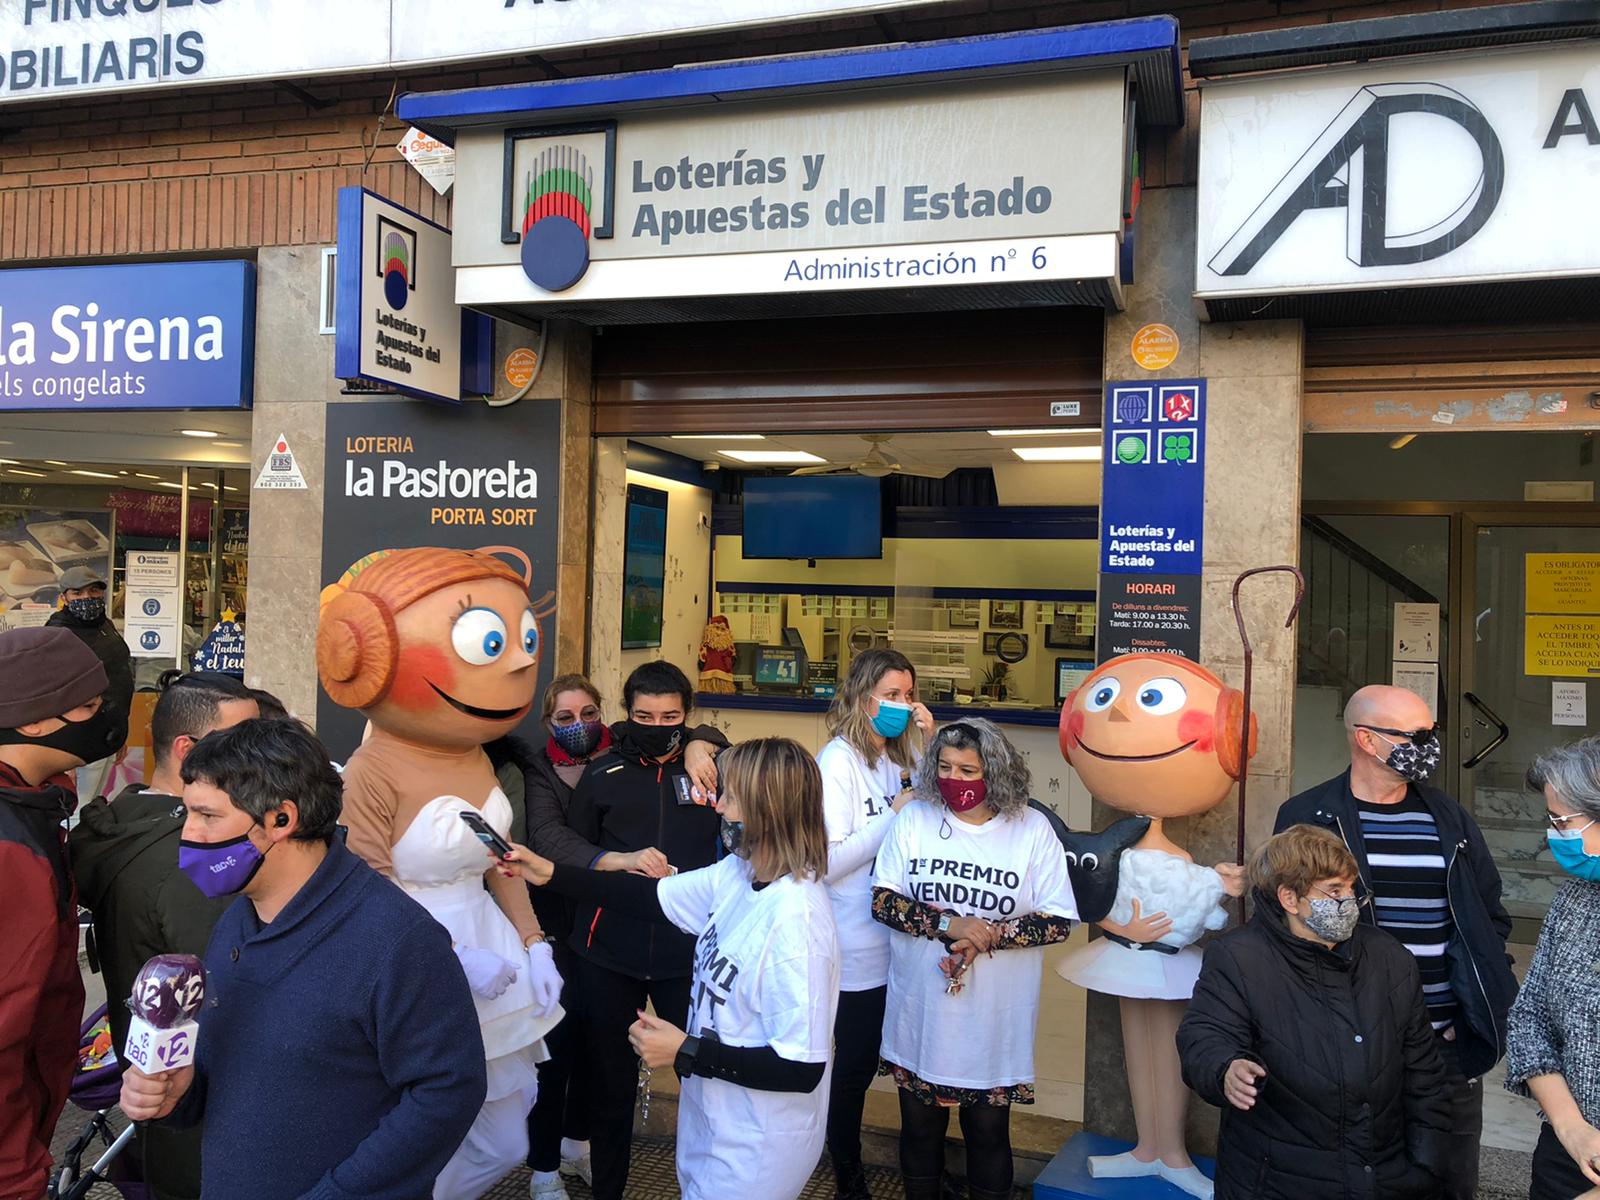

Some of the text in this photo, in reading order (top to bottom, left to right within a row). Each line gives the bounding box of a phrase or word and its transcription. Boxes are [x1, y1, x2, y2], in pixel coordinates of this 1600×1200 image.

[0, 31, 204, 90] BILIARIS
[632, 149, 825, 193] Loterías y
[632, 175, 1052, 245] Apuestas del Estado
[784, 251, 977, 283] Administración
[1031, 246, 1047, 270] 6
[50, 301, 224, 364] Sirena
[376, 308, 426, 343] Loterías y
[376, 329, 441, 364] Apuestas del
[376, 349, 412, 374] Estado
[32, 370, 146, 402] congelats
[346, 436, 414, 453] LOTERIA
[345, 459, 538, 499] la Pastoreta
[431, 508, 537, 526] PORTA SORT
[1110, 524, 1175, 540] Loterías y
[1110, 540, 1195, 554] Apuestas del
[1109, 555, 1155, 567] Estado
[1126, 583, 1176, 595] HORARI
[1123, 603, 1146, 611] dilluns
[1153, 604, 1190, 612] divendres:
[1157, 613, 1179, 621] 13.30
[1179, 613, 1186, 621] h.
[1161, 621, 1183, 630] 20.30
[1183, 622, 1191, 630] h.
[1553, 623, 1583, 631] ANTES
[1537, 632, 1578, 640] ACCEDER
[1560, 641, 1592, 649] TIMBRE
[206, 654, 220, 670] el
[1536, 650, 1573, 658] ACCEDA
[1538, 658, 1550, 666] SE
[776, 660, 797, 678] 41
[1566, 702, 1572, 712] 2
[209, 860, 228, 874] tac
[929, 858, 1020, 890] PREMIO
[909, 882, 1016, 916] VENDIDO
[128, 1035, 148, 1067] tac
